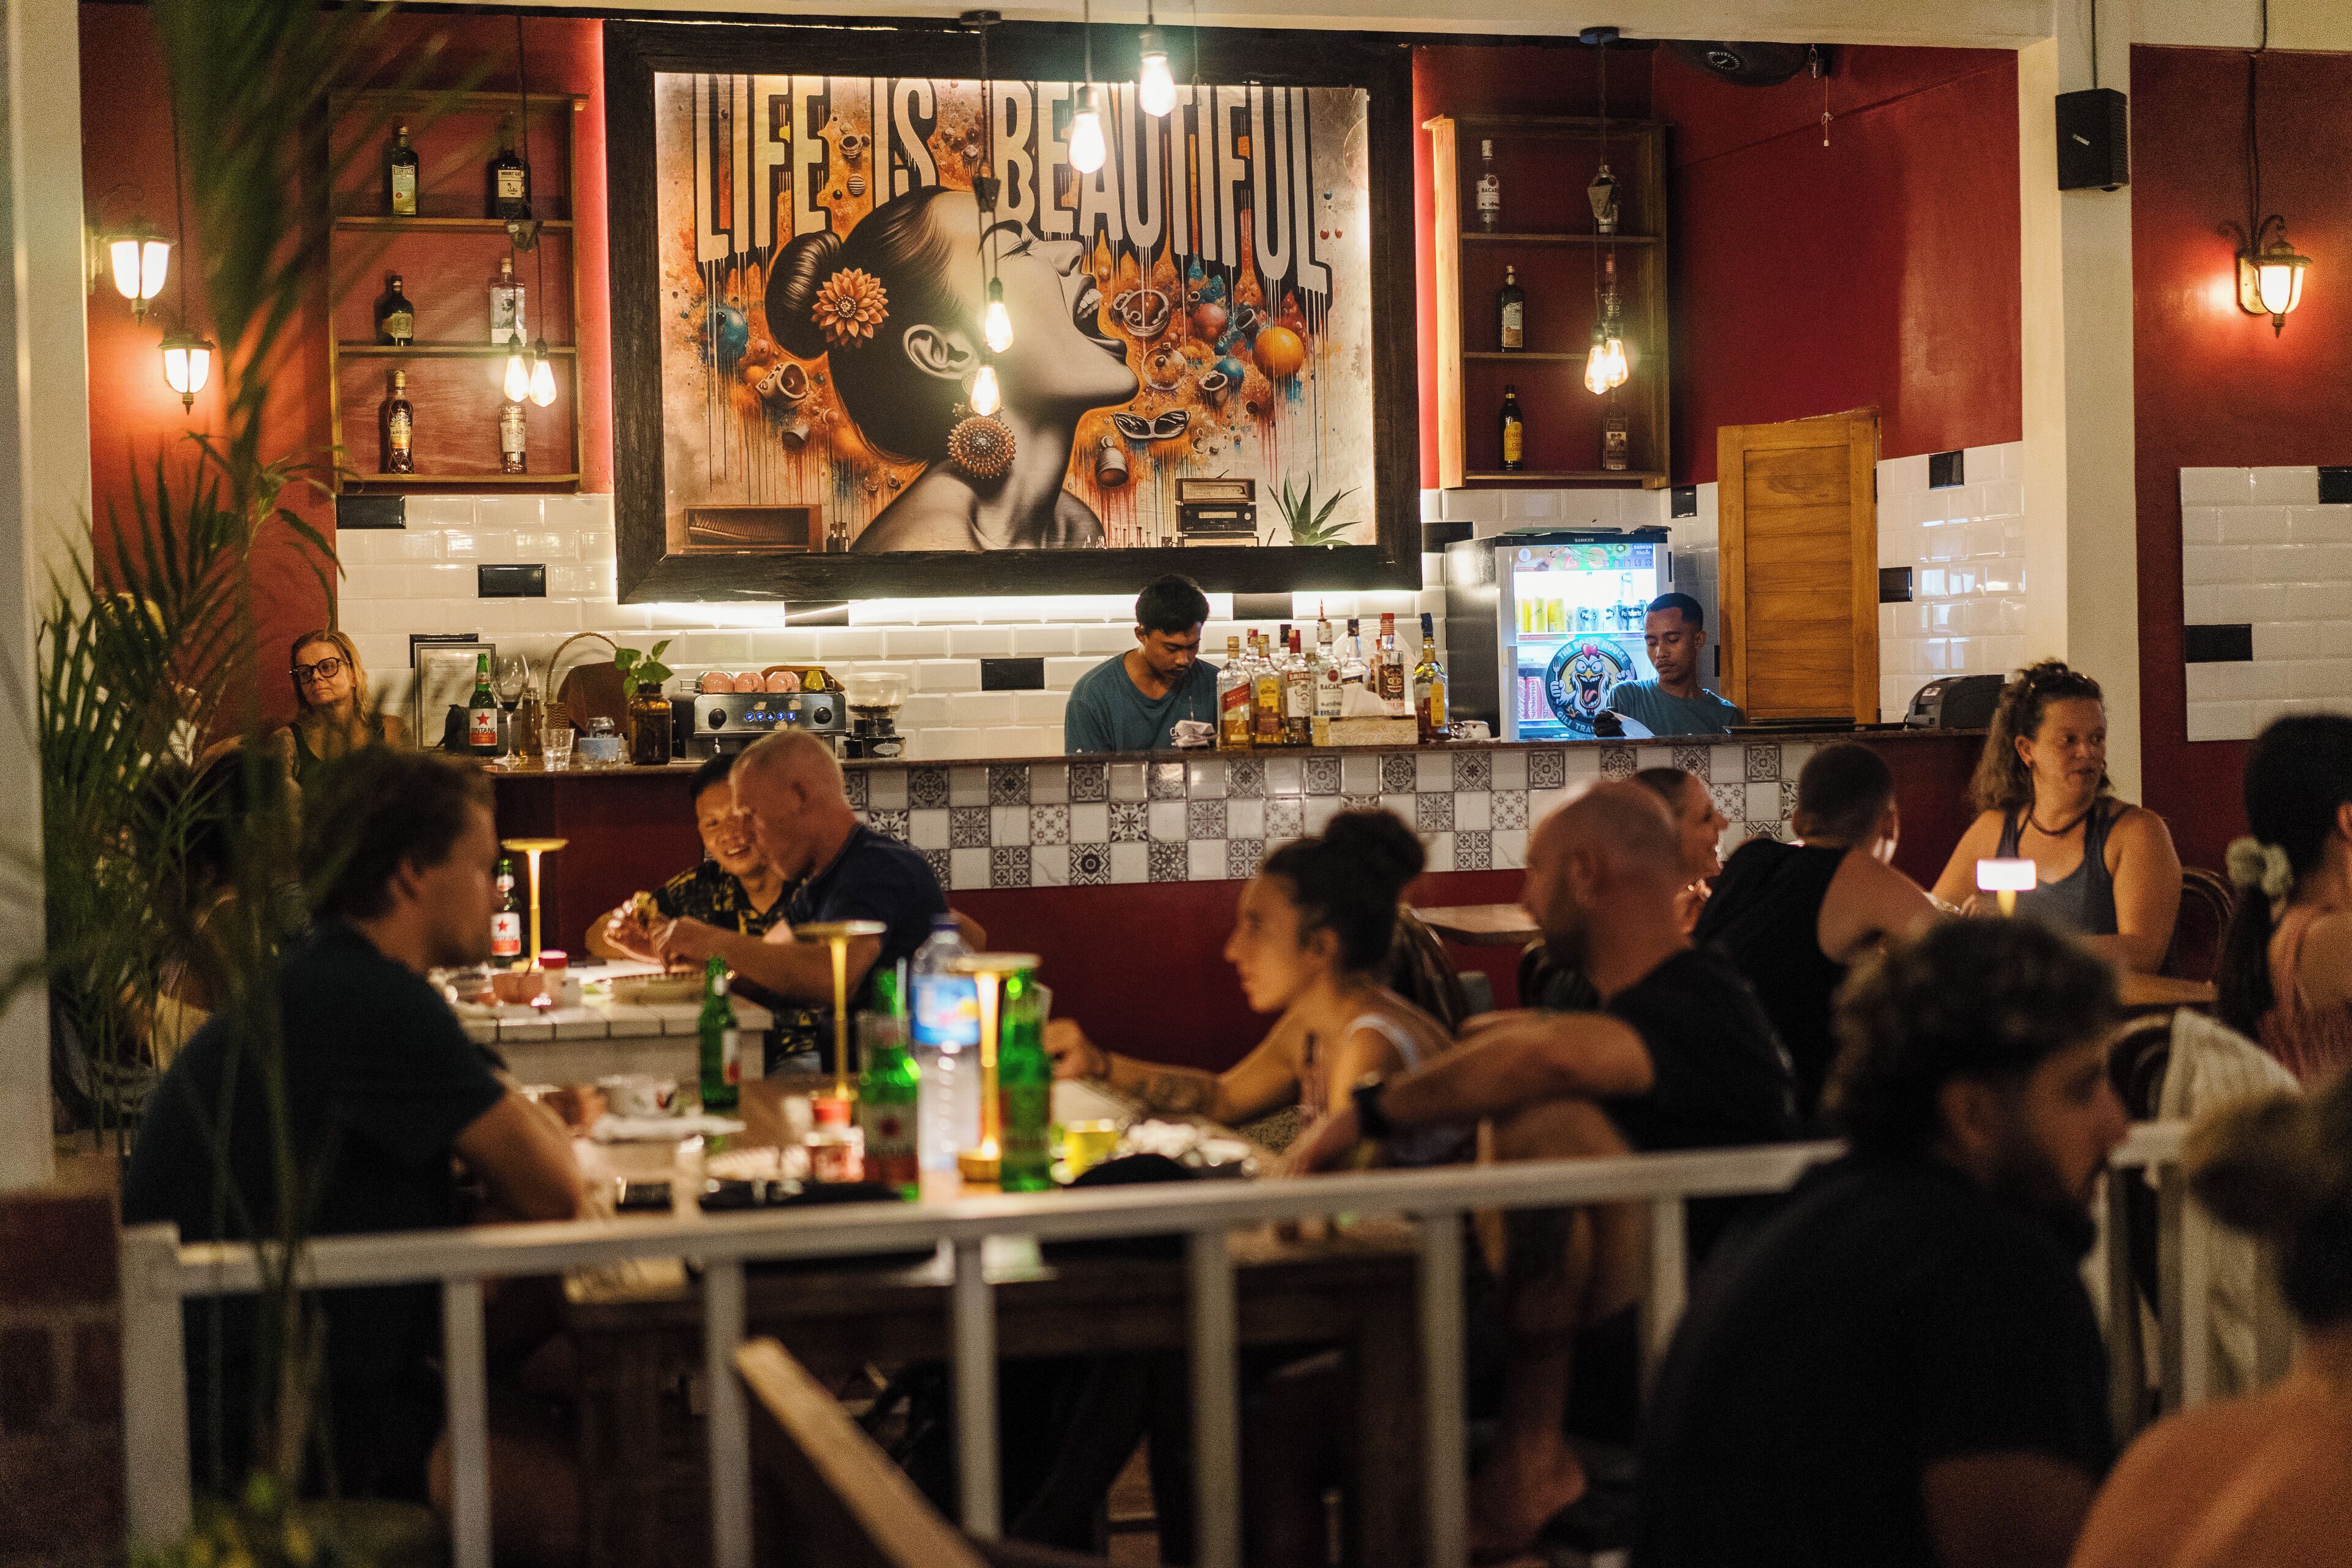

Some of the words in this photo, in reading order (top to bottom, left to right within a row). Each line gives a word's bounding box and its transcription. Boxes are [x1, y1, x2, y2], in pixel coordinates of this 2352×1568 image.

[695, 74, 825, 262] LIFE
[872, 78, 936, 207] IS
[992, 80, 1329, 293] BEAUTIFUL
[1557, 644, 1574, 660] THE
[1602, 640, 1629, 663] HOUSE
[1556, 711, 1572, 726] GILI
